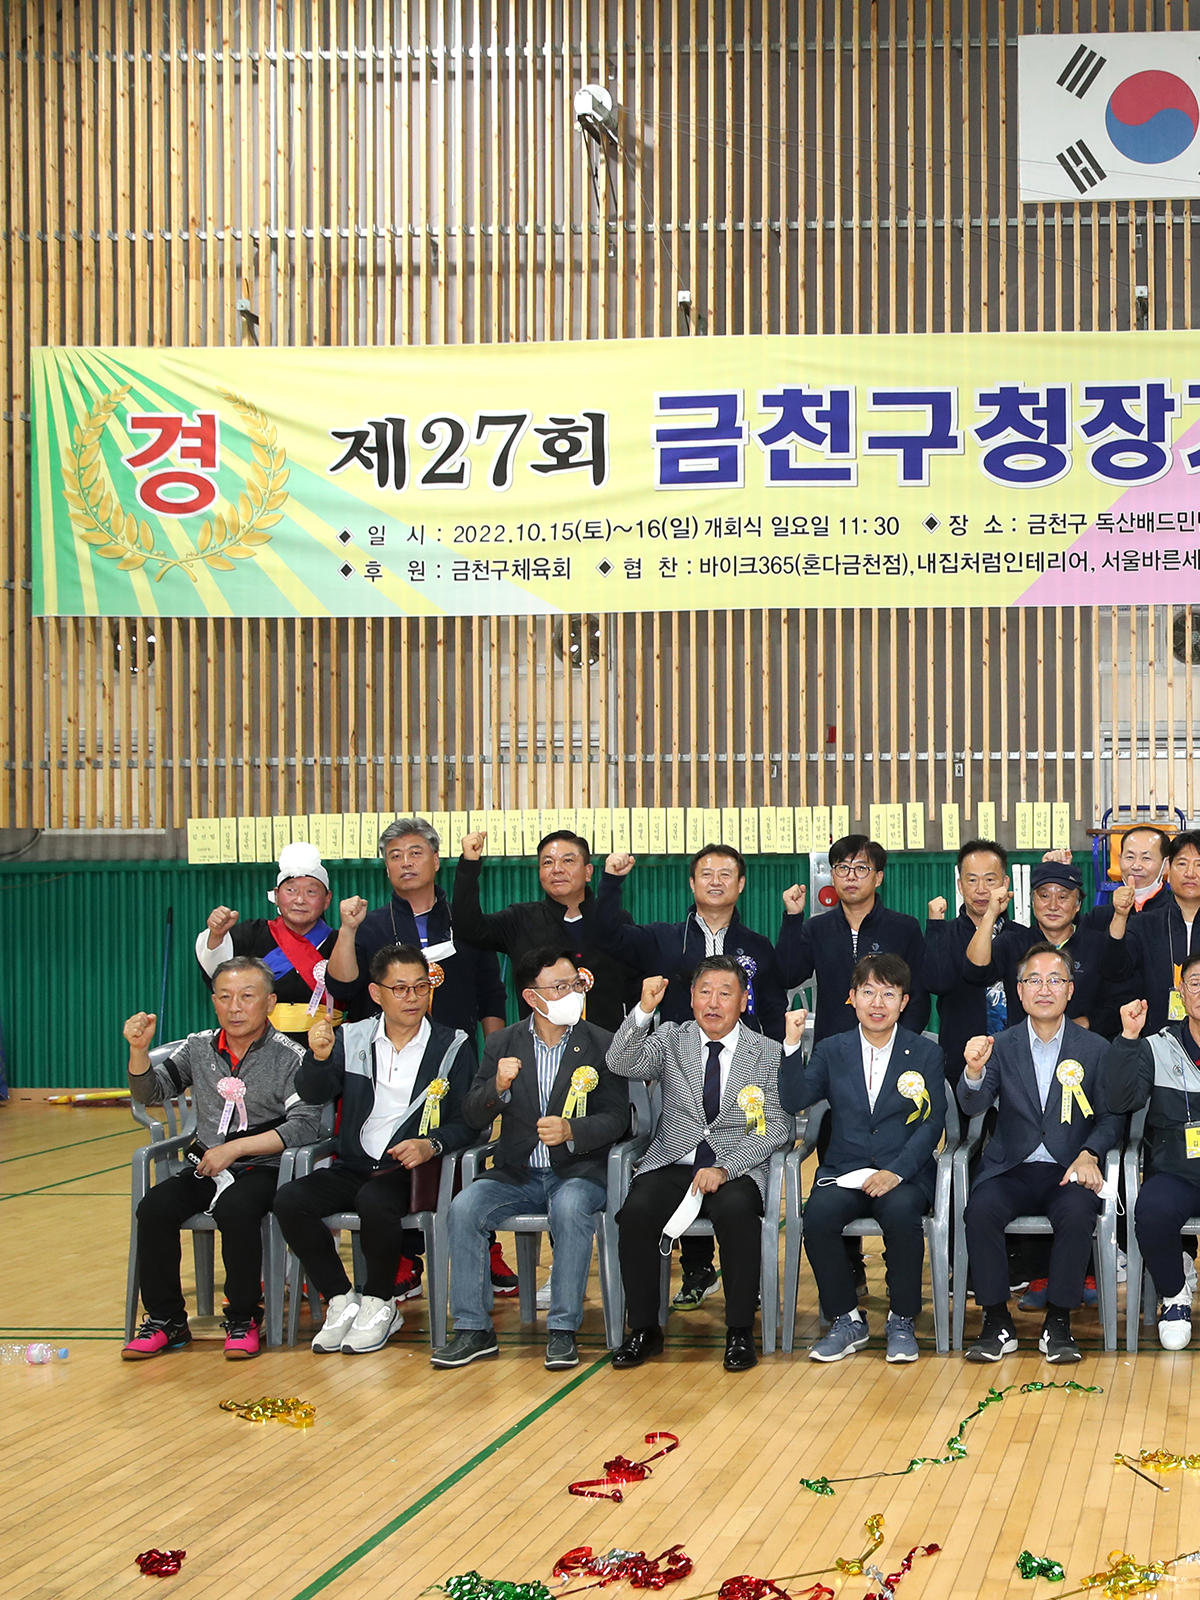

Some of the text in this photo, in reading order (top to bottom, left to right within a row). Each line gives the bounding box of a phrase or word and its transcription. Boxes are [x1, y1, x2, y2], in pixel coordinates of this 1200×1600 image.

[329, 412, 606, 491] 제27회
[128, 414, 216, 514] 경
[704, 516, 761, 539] 개회식
[771, 515, 829, 537] 일요일
[1027, 513, 1088, 535] 금천구
[451, 557, 570, 581] 금천구체육회
